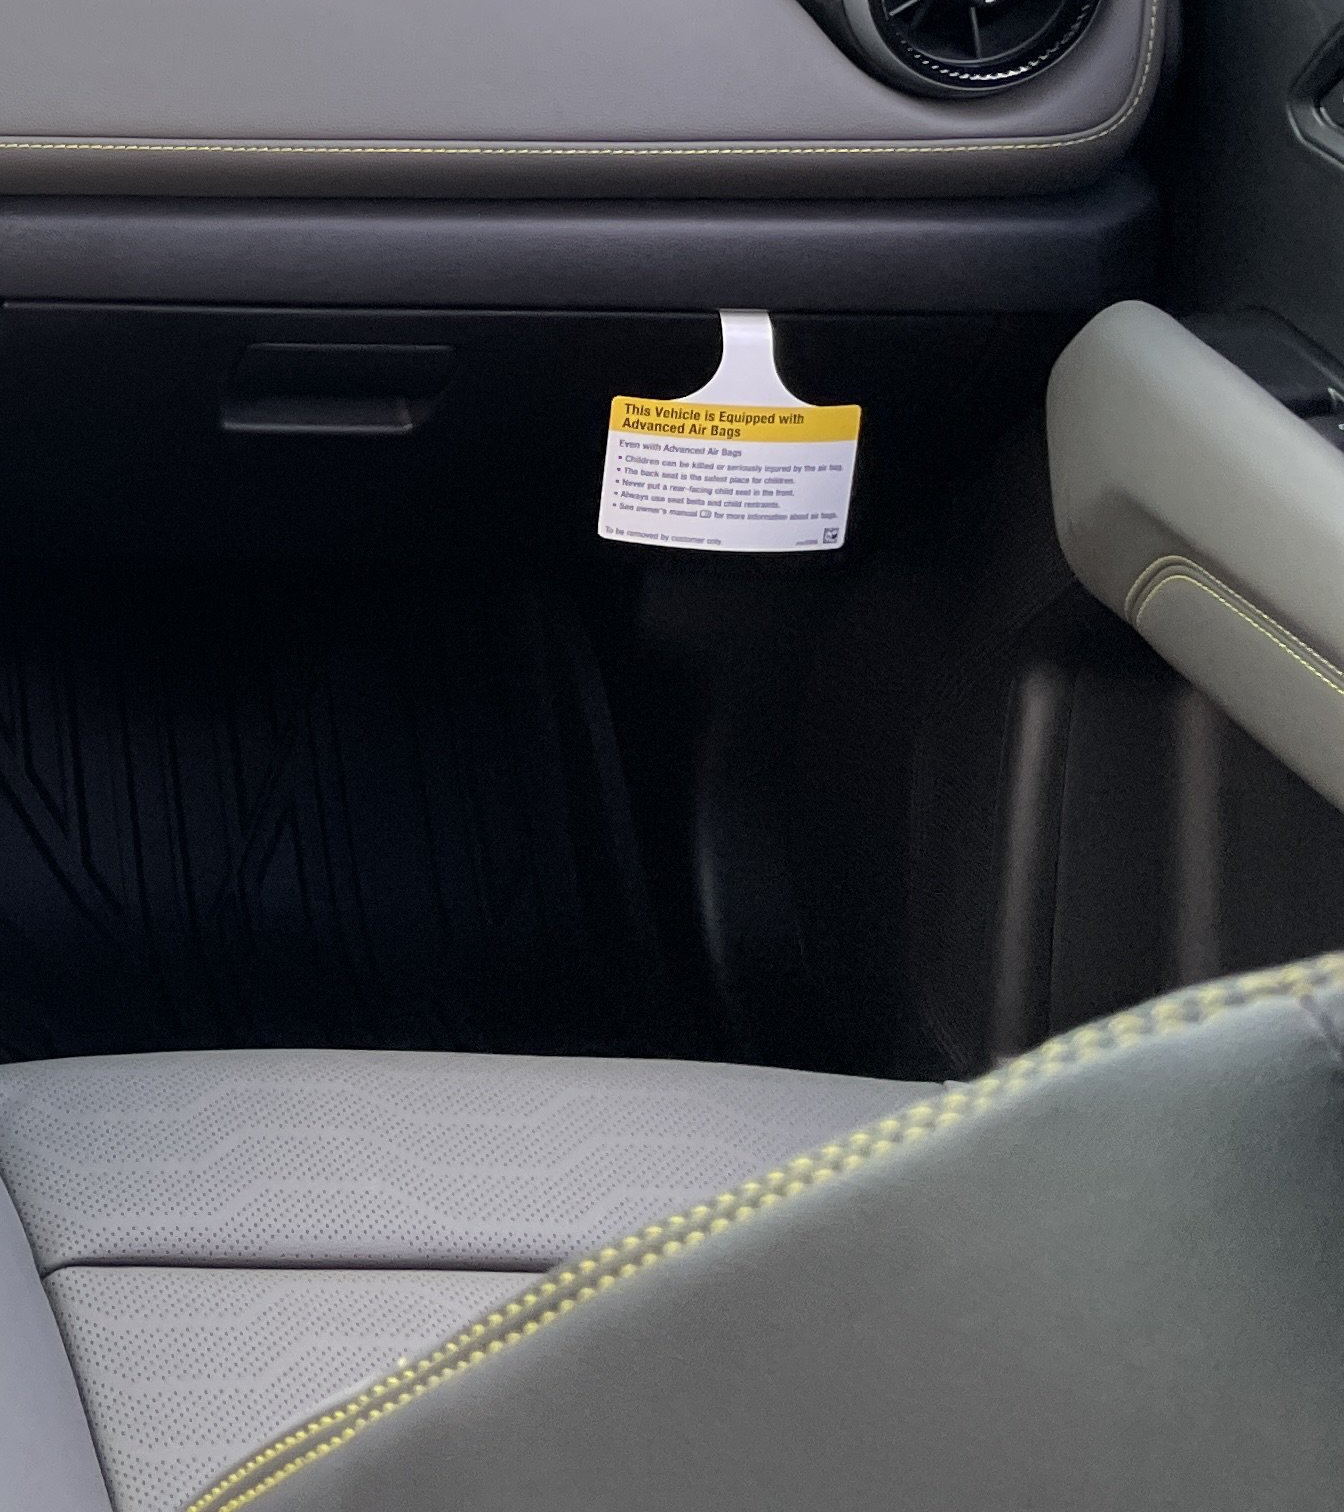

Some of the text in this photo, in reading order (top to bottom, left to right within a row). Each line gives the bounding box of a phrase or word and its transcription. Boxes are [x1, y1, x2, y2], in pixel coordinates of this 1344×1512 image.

[624, 403, 805, 427] This Vehicle is Equipped with
[622, 417, 741, 440] Advanced Air Bags
[619, 439, 742, 457] Even with Advanced Air Bags
[625, 455, 659, 465] Children
[625, 467, 638, 475] The
[641, 469, 659, 477] back
[622, 479, 645, 488] Never
[647, 482, 660, 490] put
[621, 491, 648, 501] Always
